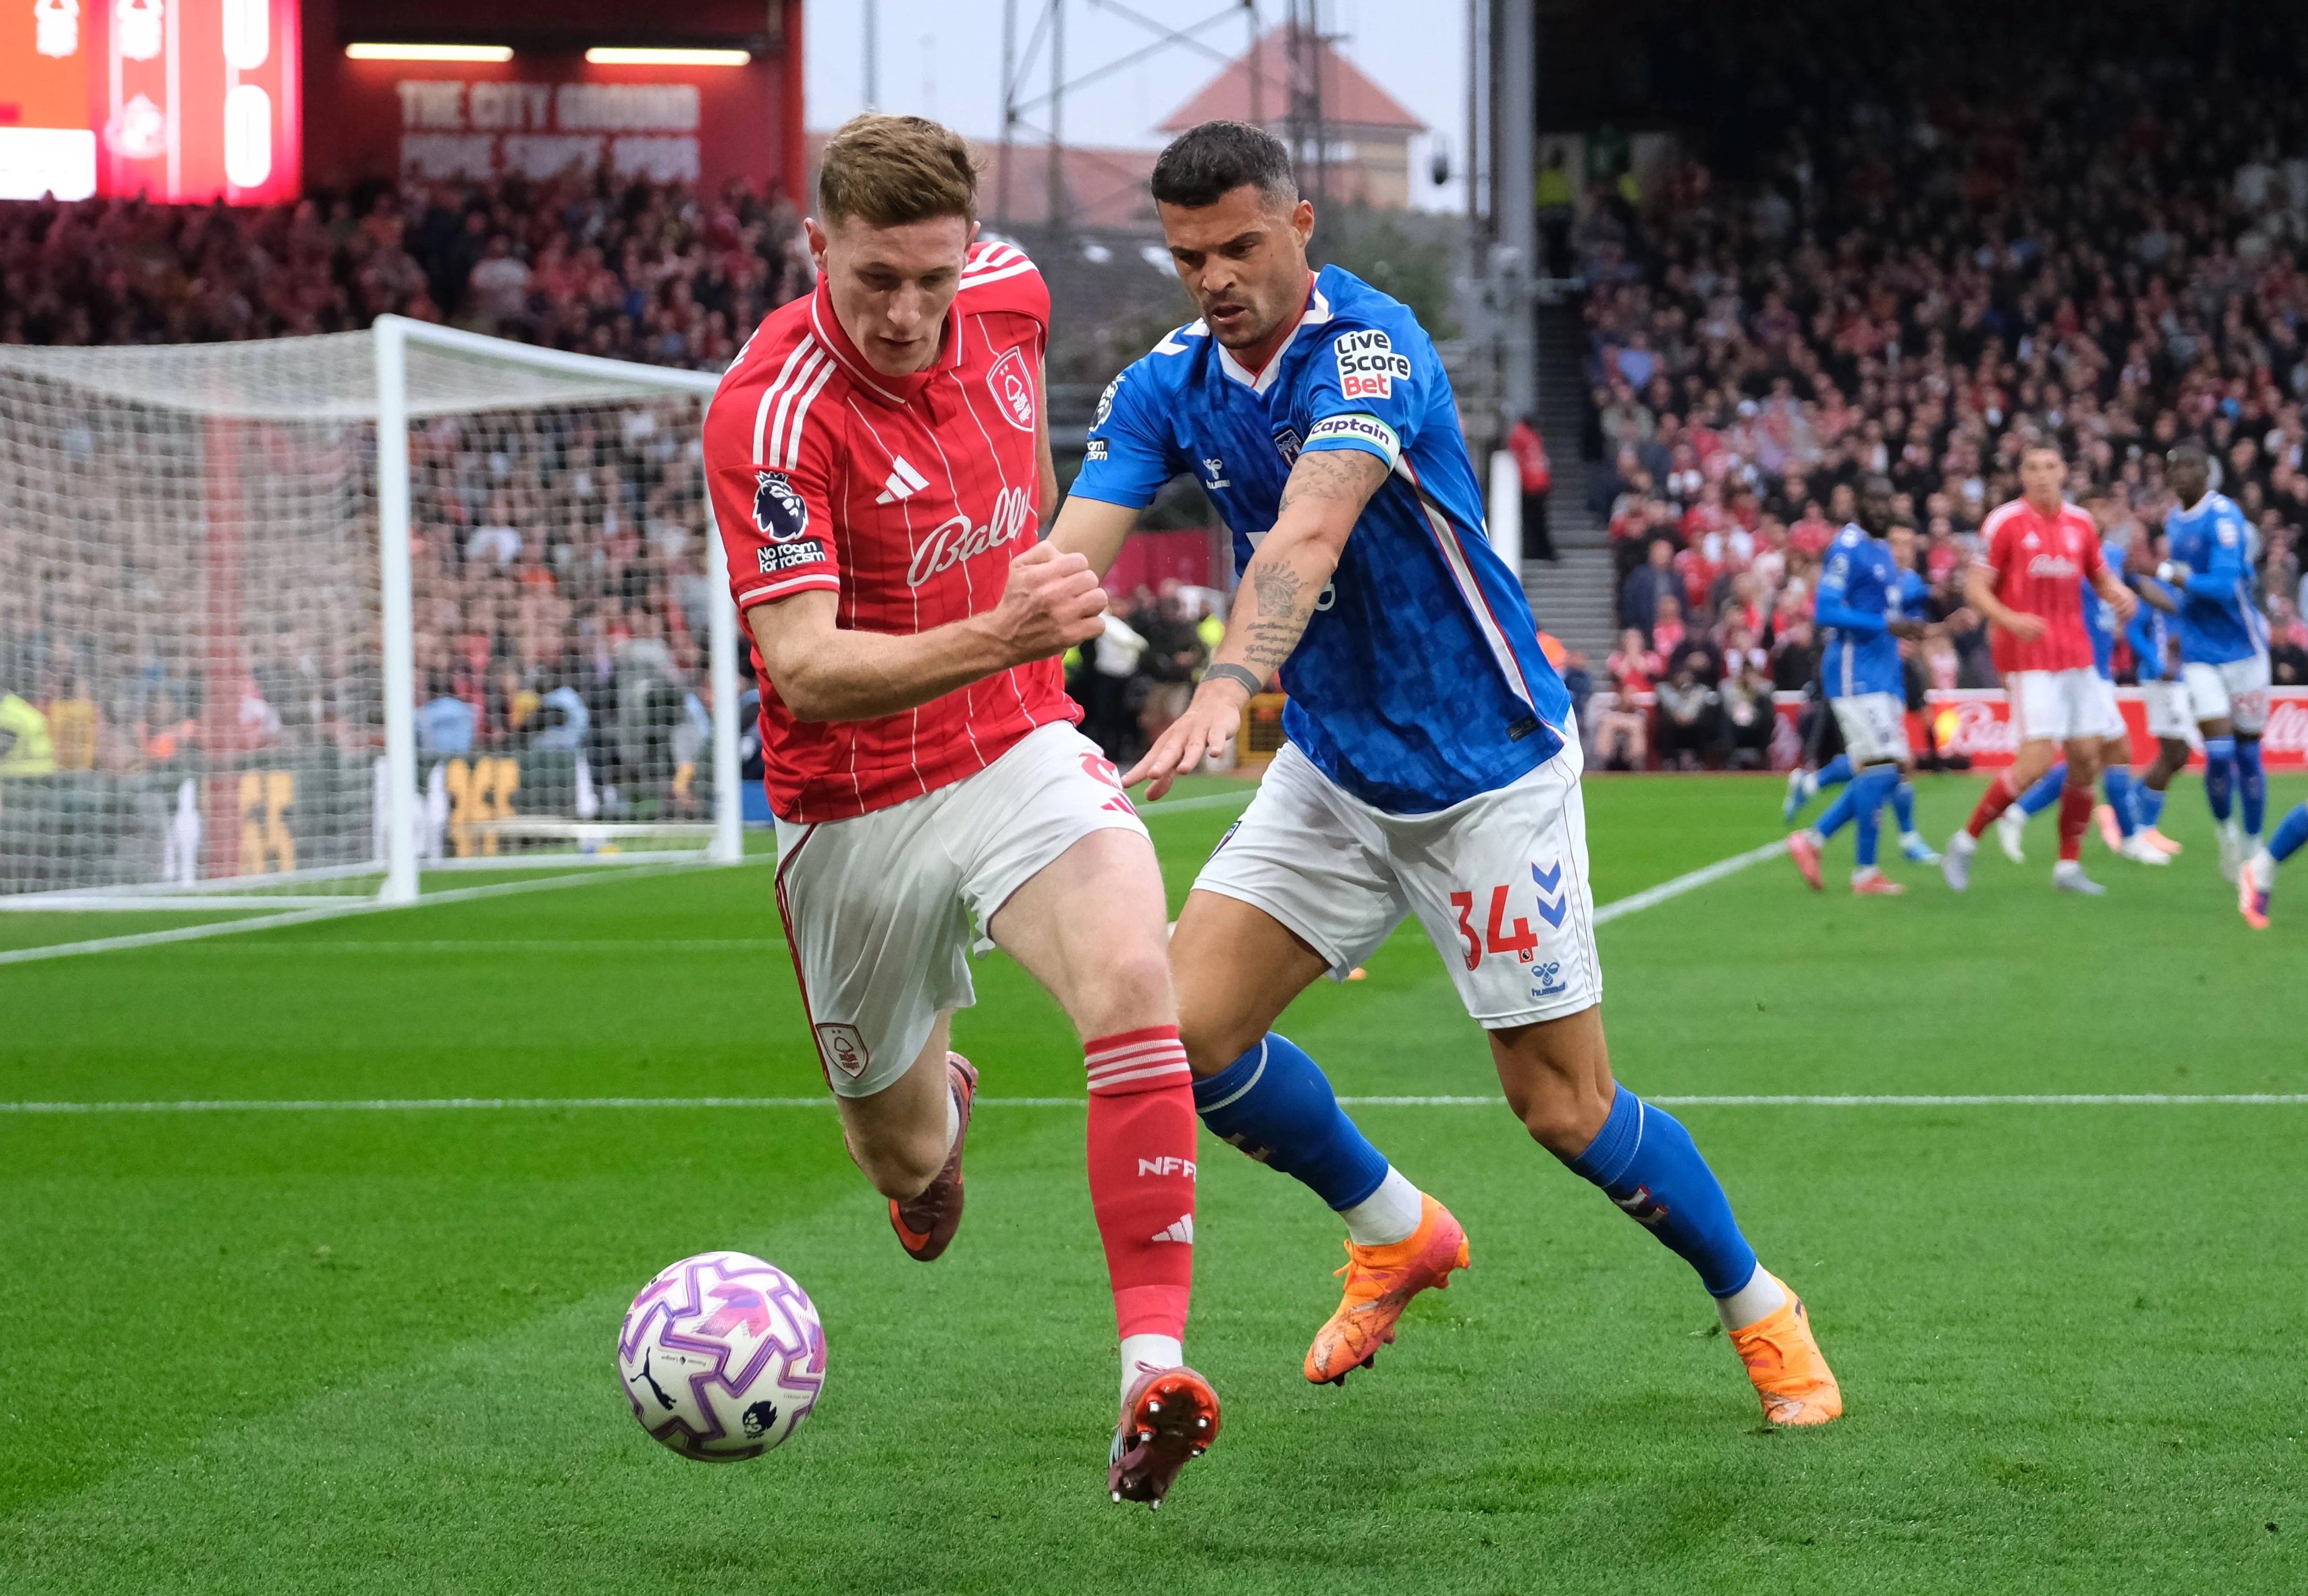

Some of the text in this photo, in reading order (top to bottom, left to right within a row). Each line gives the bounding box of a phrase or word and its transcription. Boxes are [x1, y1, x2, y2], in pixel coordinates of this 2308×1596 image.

[1337, 333, 1388, 354] Live
[1340, 355, 1408, 376] Score
[1344, 373, 1389, 397] Bet
[757, 541, 817, 561] No room
[759, 551, 827, 573] for racism
[1450, 884, 1539, 971] 34
